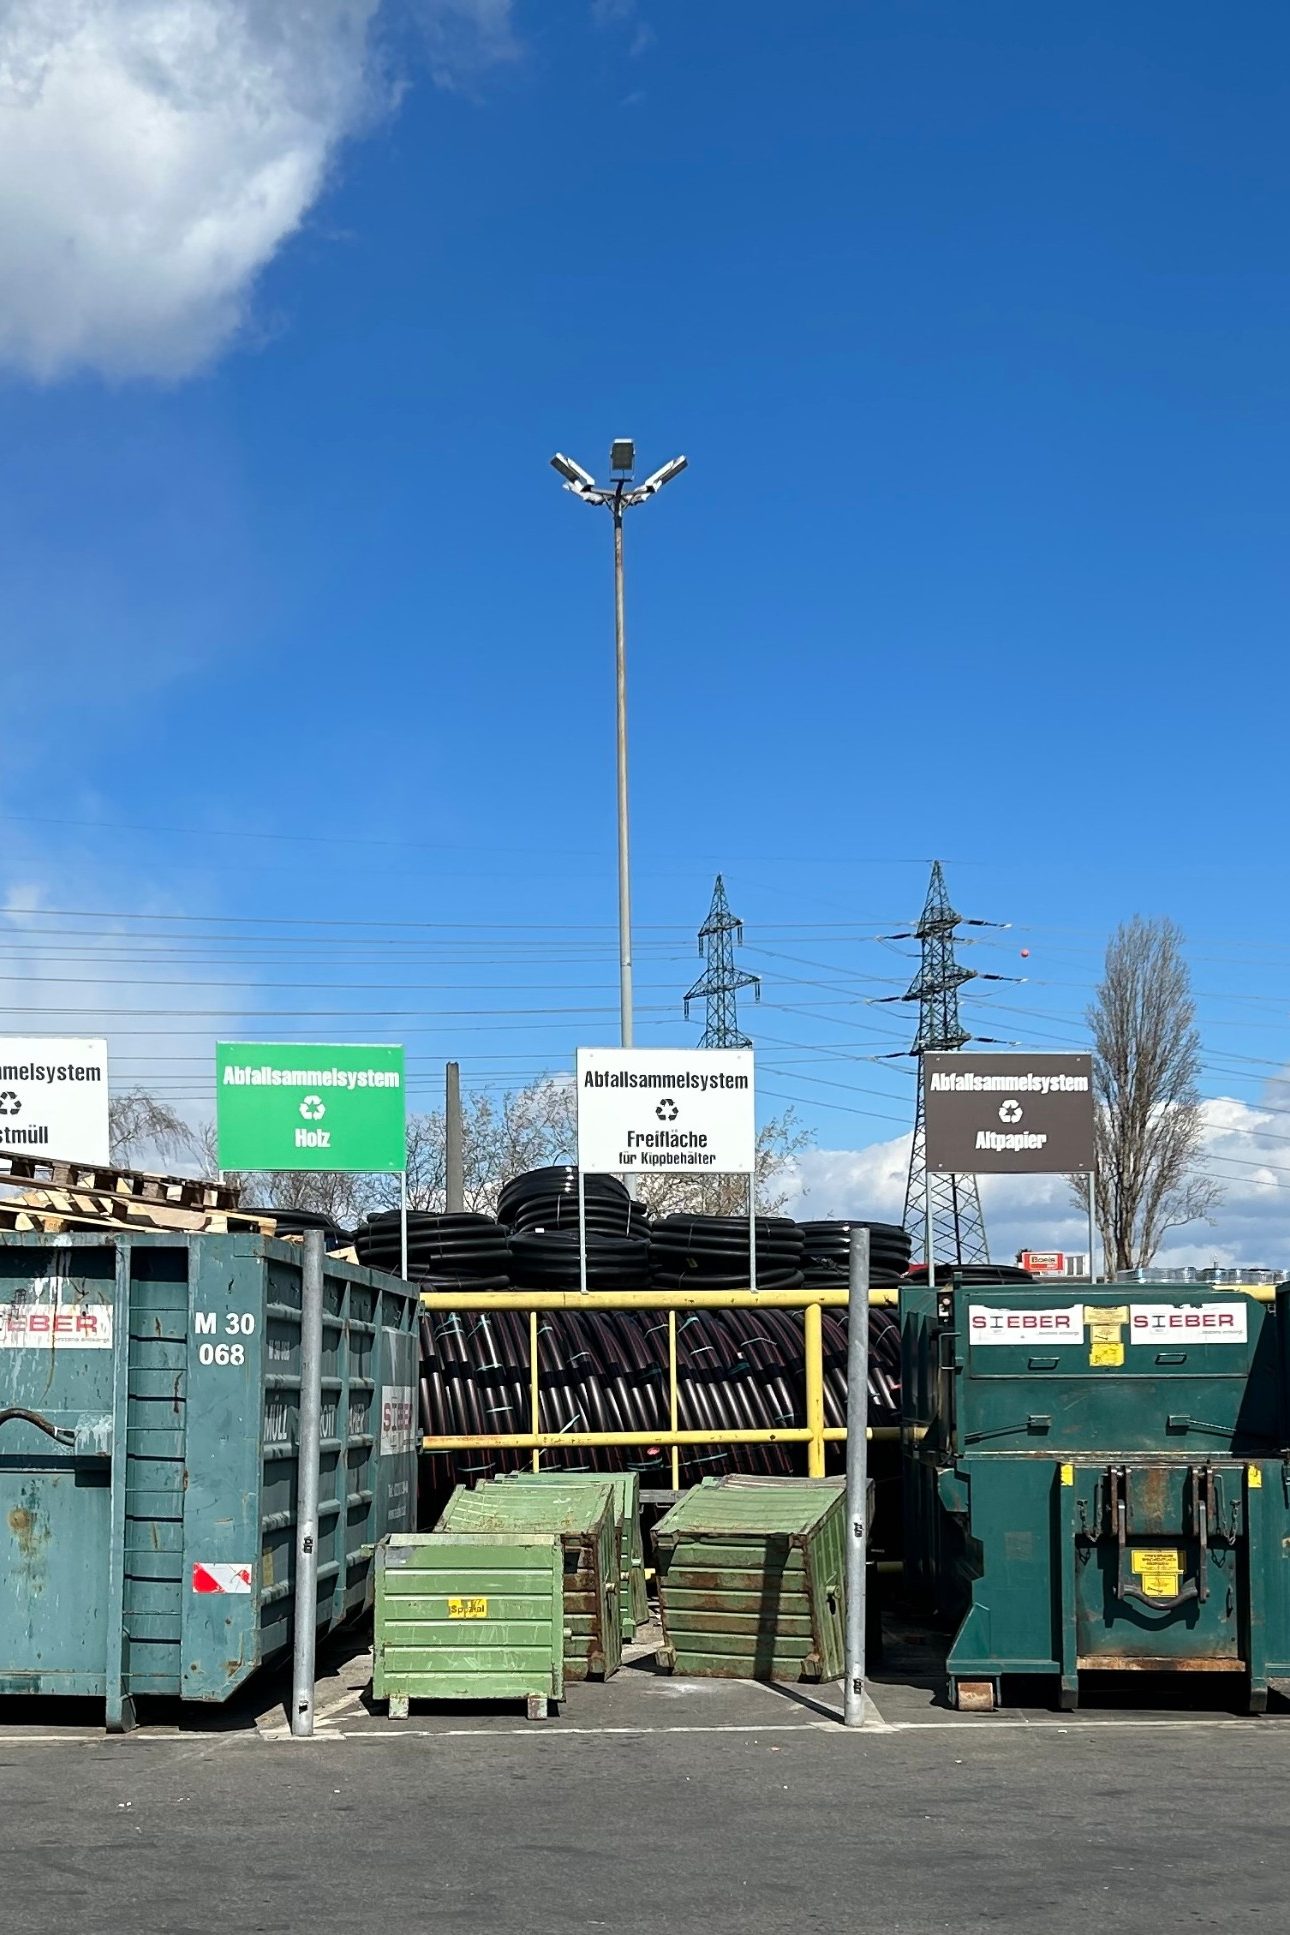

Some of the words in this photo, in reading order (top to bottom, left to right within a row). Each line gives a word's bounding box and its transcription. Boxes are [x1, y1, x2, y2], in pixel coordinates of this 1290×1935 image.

[0, 1063, 101, 1084] melsystem
[223, 1066, 400, 1090] Abfallsammelsystem
[584, 1070, 749, 1091] Abfallsammelsystem
[930, 1073, 1089, 1094] Abfallsammelsystem
[295, 1128, 331, 1148] Holz
[627, 1129, 708, 1148] Freifläche
[975, 1130, 1047, 1152] Altpapier
[619, 1151, 637, 1165] für
[641, 1151, 716, 1167] Kippbehälter
[0, 1315, 98, 1332] EBER
[194, 1311, 217, 1335] M
[224, 1312, 255, 1335] 30
[972, 1315, 1070, 1328] SIEBER
[1133, 1313, 1234, 1328] SIEBER
[199, 1343, 245, 1365] 068
